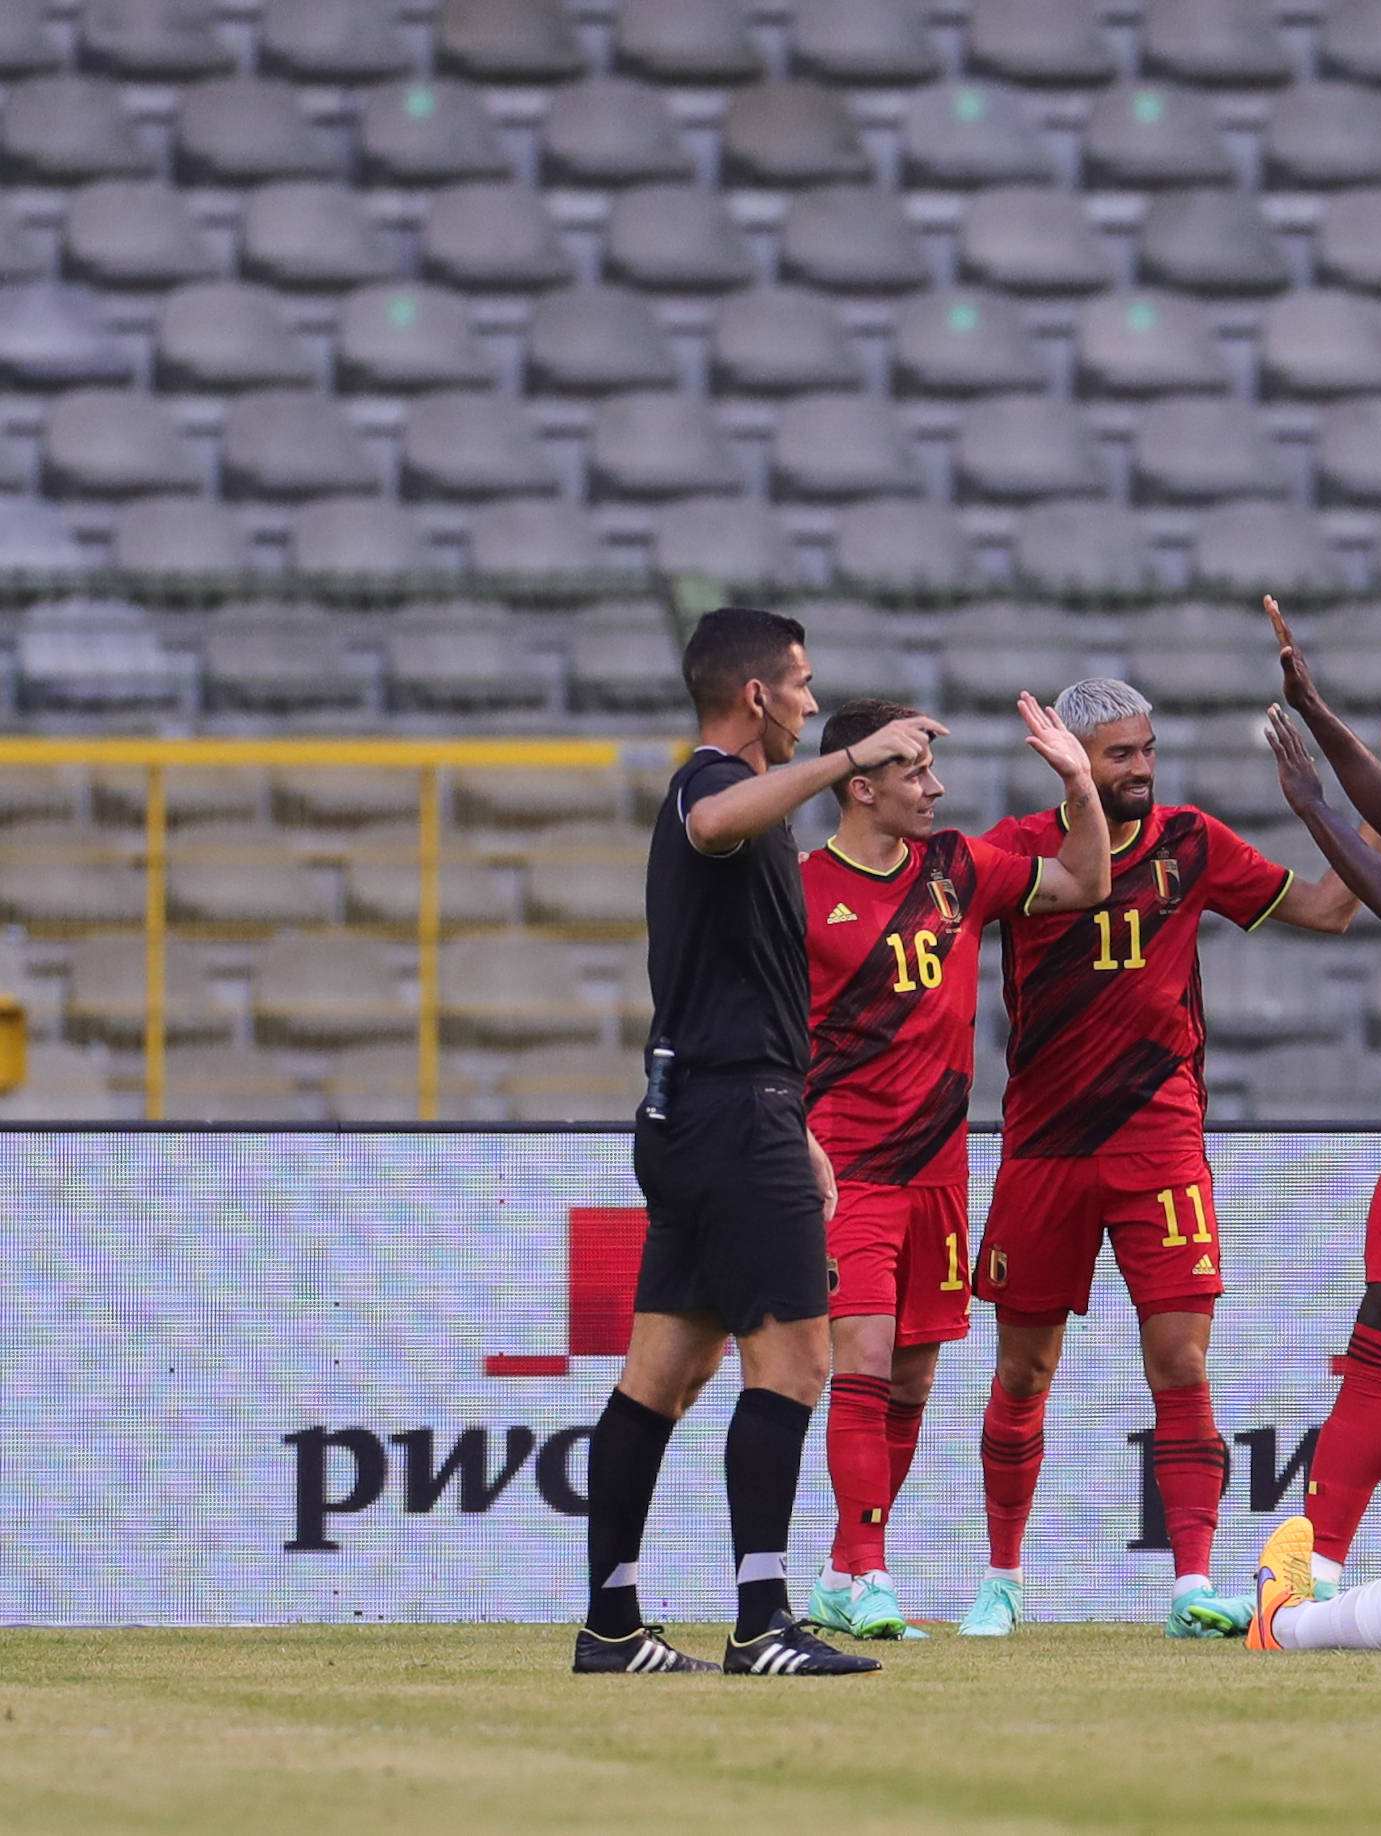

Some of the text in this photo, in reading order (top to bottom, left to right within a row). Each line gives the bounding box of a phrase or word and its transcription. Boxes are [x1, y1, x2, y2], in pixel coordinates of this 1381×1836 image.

[886, 929, 943, 993] 16
[1093, 908, 1147, 970] 11
[1157, 1184, 1213, 1248] 11
[940, 1232, 964, 1291] 1
